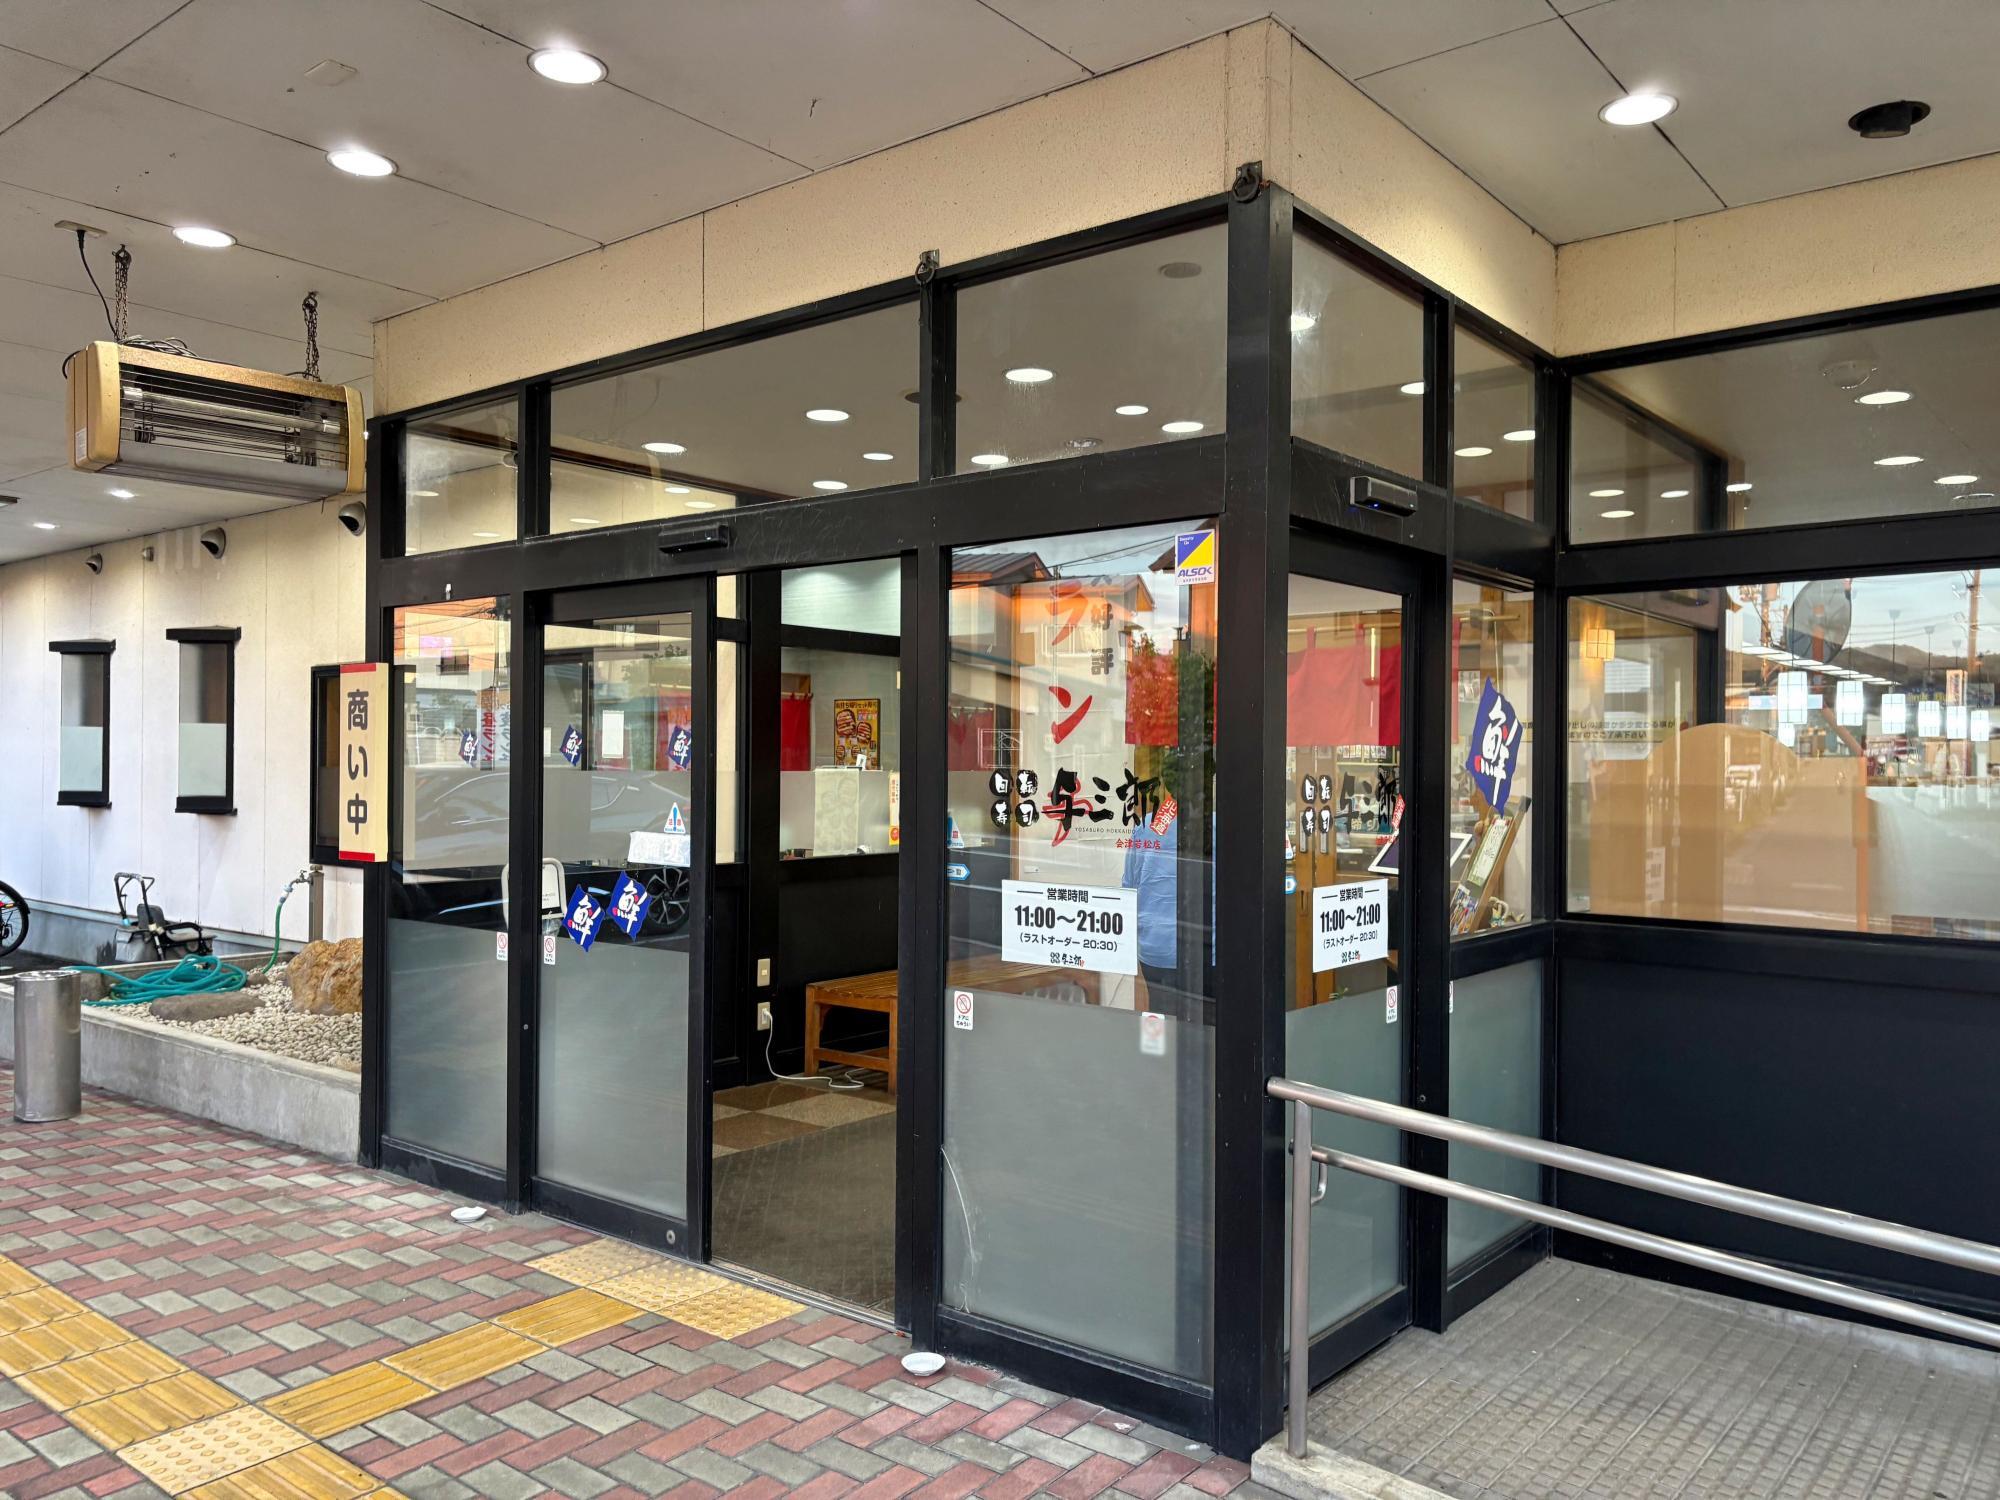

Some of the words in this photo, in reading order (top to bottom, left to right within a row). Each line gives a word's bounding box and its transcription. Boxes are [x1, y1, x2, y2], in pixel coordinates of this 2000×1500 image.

[1178, 567, 1213, 577] ALSOK
[346, 688, 370, 836] 商い中
[993, 770, 1038, 796] 回転
[1041, 767, 1162, 832] 与三郎
[993, 801, 1037, 827] 寿司
[1115, 838, 1162, 850] 会津若松店
[1046, 887, 1089, 904] 営業時間
[1339, 886, 1364, 902] 営業時間
[1082, 939, 1118, 952] 20:30)
